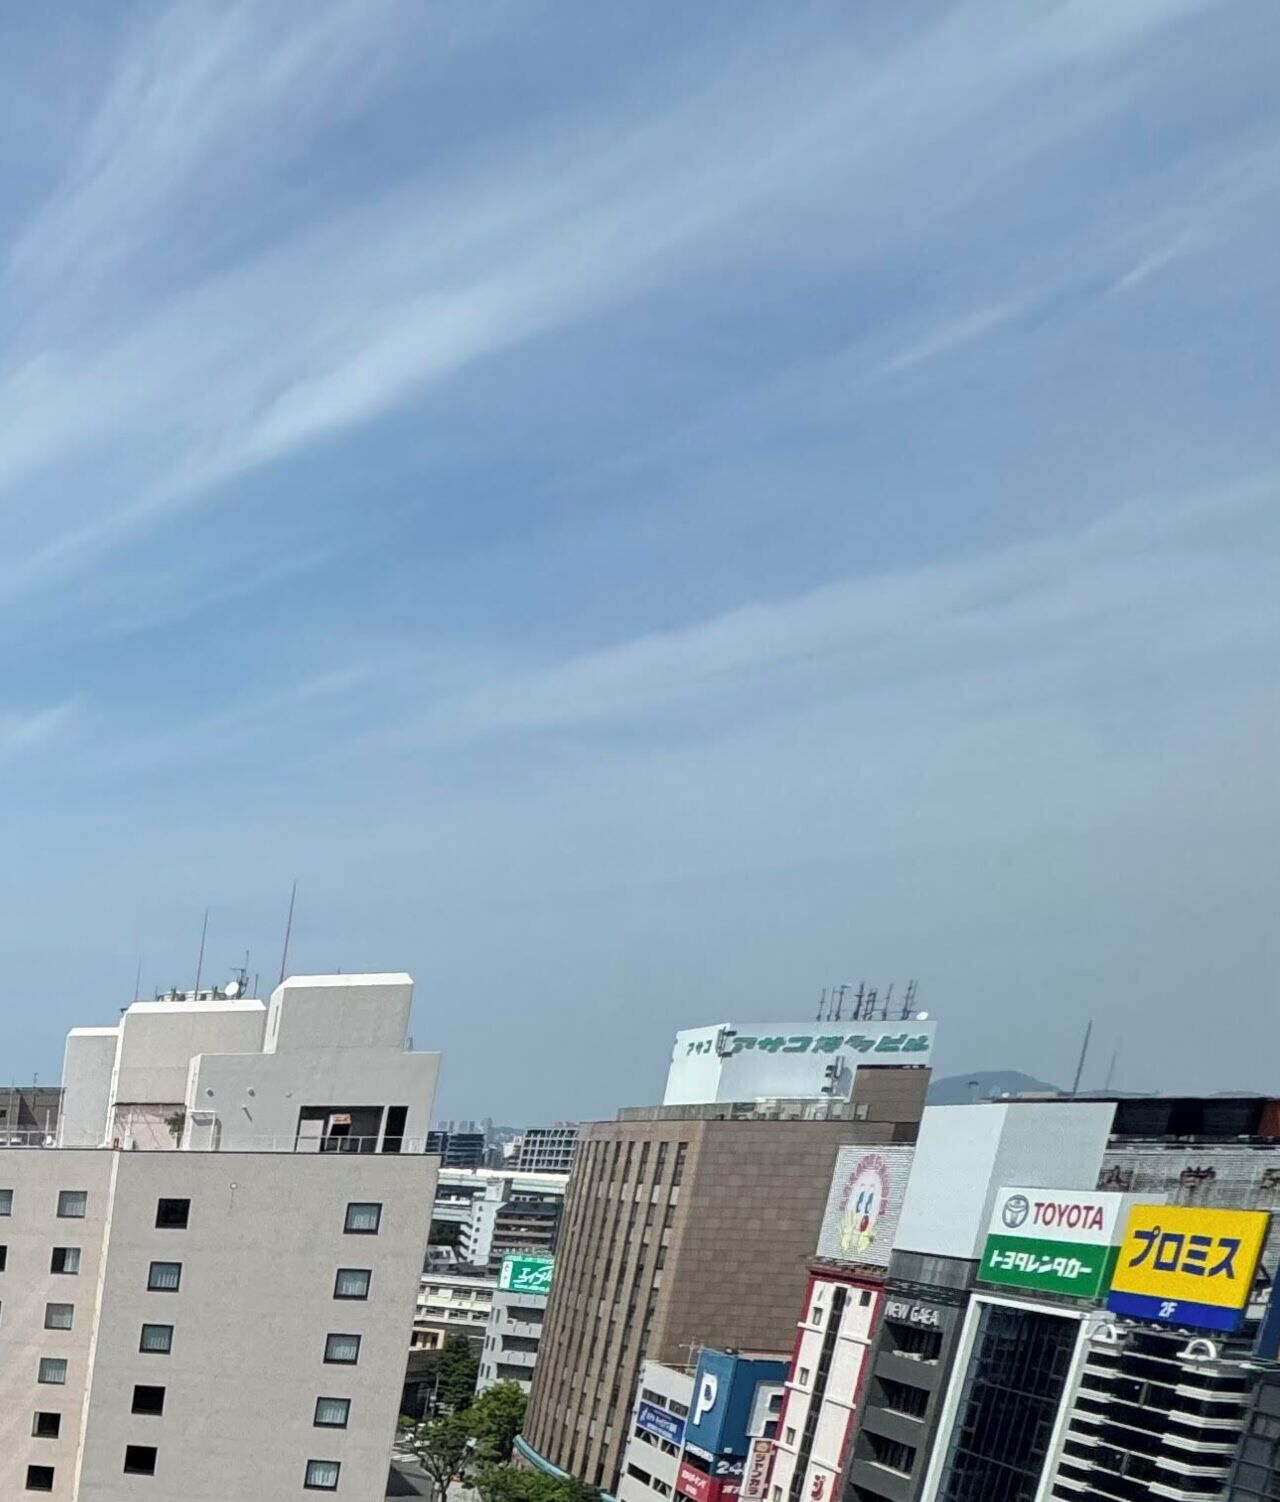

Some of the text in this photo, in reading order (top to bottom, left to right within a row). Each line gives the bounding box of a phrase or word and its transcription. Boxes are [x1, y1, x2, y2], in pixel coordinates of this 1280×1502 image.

[1033, 1202, 1104, 1230] TOYOTA
[989, 1249, 1093, 1279] トヨタレンタカー
[1129, 1225, 1242, 1280] プロミス
[1159, 1301, 1178, 1318] 2F
[692, 1371, 719, 1426] P
